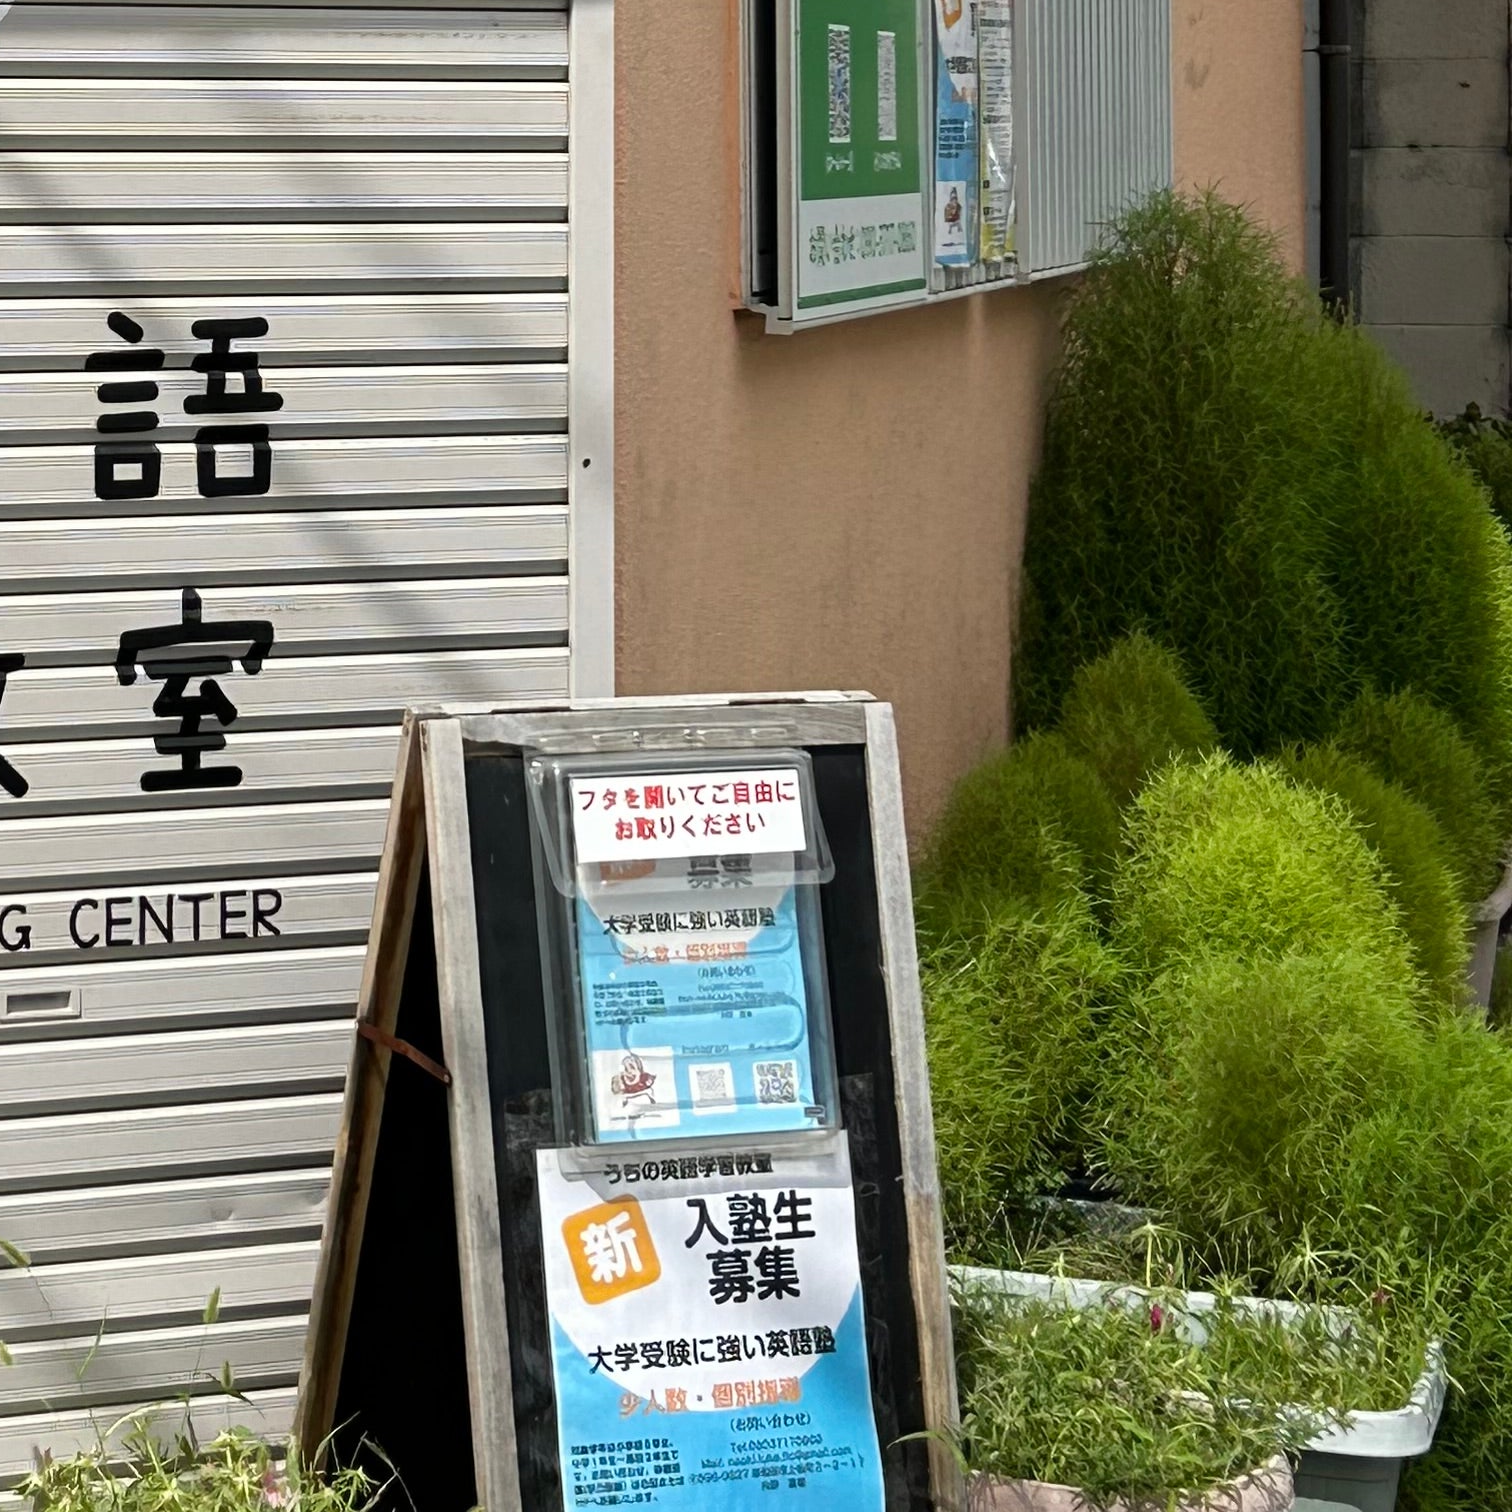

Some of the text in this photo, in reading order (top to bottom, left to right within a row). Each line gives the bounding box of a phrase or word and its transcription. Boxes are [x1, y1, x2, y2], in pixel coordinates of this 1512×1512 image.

[577, 779, 796, 811] フタを開いてご自由に
[614, 812, 766, 841] お取りください
[69, 888, 283, 949] CENTER
[578, 1210, 645, 1286] 新
[683, 1189, 817, 1249] 入塾生
[705, 1245, 801, 1305] 募集
[587, 1325, 838, 1375] 大学受験に強い英語塾
